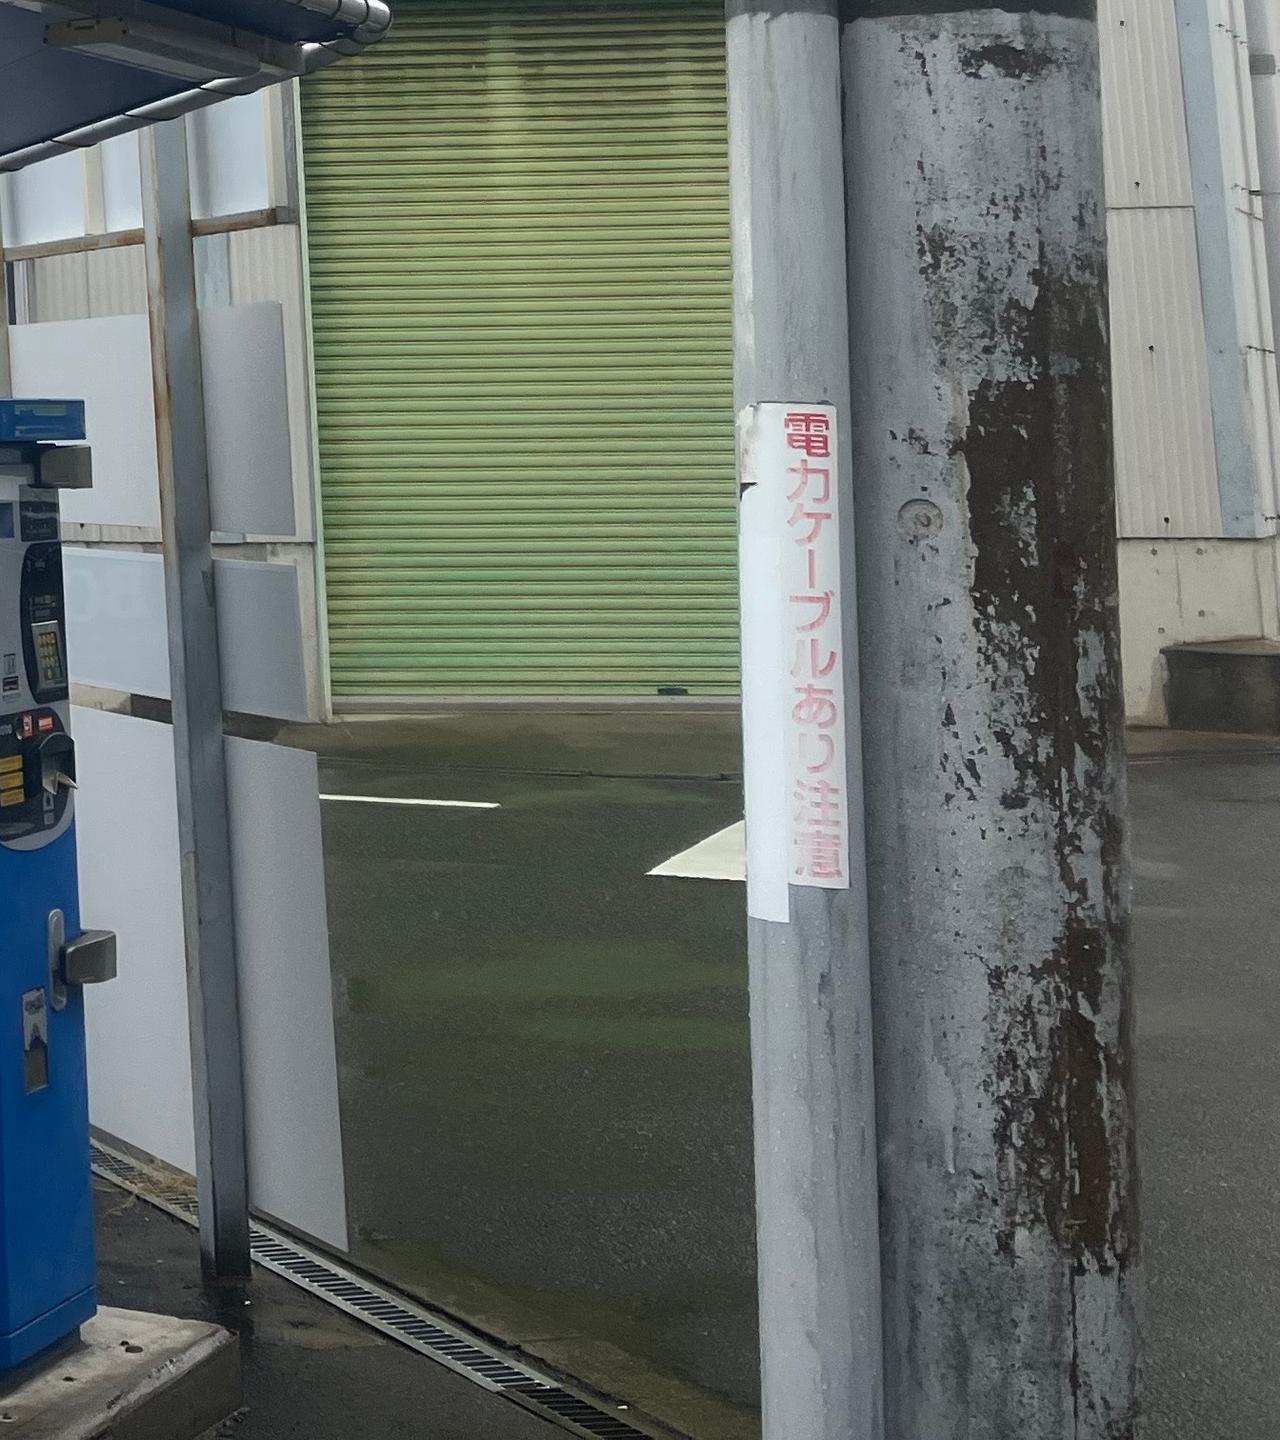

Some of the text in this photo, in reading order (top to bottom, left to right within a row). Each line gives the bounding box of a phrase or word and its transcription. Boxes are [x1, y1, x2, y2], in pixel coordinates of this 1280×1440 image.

[784, 411, 842, 880] 電力ケーブルあり注意
